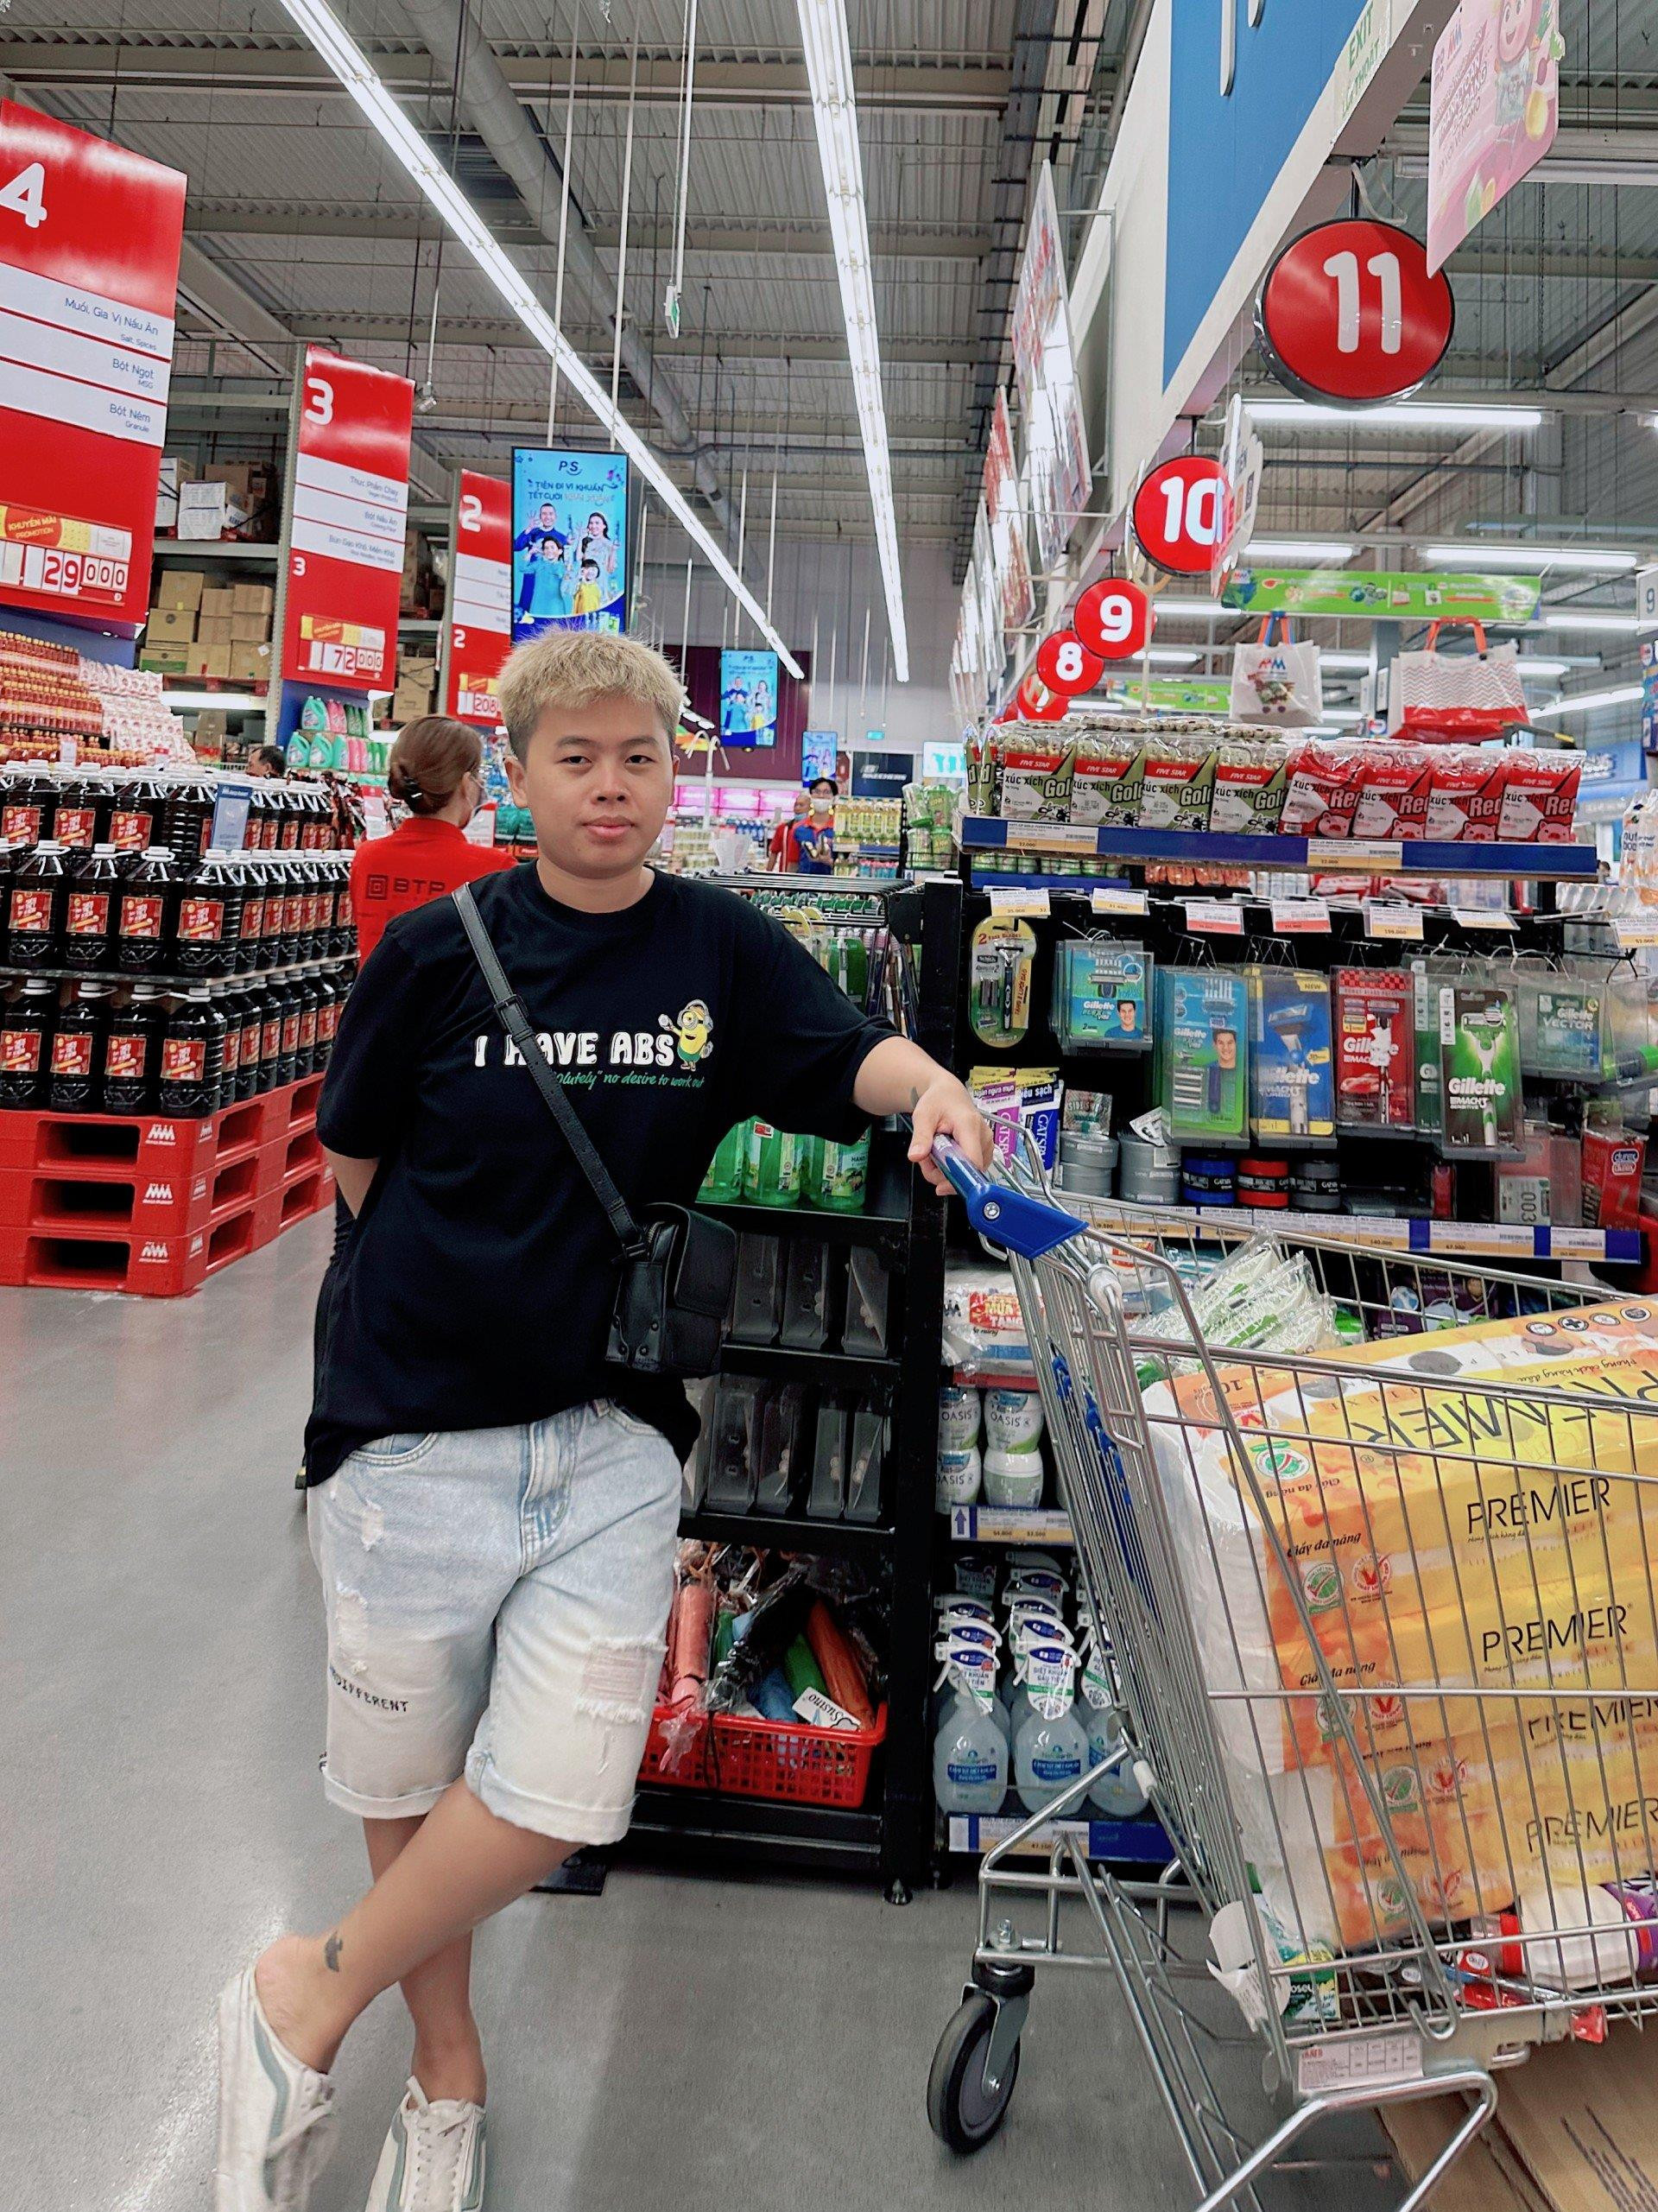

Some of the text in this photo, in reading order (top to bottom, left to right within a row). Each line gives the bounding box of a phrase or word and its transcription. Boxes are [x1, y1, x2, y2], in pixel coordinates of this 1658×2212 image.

[0, 162, 47, 228] 4
[93, 307, 108, 320] Gia
[1323, 250, 1402, 354] 11
[305, 377, 333, 426] 3
[461, 494, 483, 532] 2
[1161, 475, 1222, 546] 10
[293, 557, 306, 576] 3
[1646, 587, 1655, 614] 9
[1099, 594, 1133, 643] 9
[454, 629, 465, 648] 2
[1055, 642, 1084, 681] 8
[978, 933, 988, 945] 2
[1083, 1000, 1116, 1011] Gillette
[1557, 1007, 1593, 1021] Gillette
[1174, 1027, 1206, 1038] Gillette
[475, 1035, 488, 1067] I
[610, 1031, 674, 1067] ABS
[1344, 1036, 1399, 1055] Gille
[604, 1074, 620, 1084] no
[621, 1071, 656, 1085] desire
[658, 1075, 668, 1086] to
[1448, 1077, 1506, 1096] Gillette
[1521, 1191, 1536, 1222] 003
[941, 1410, 972, 1422] OASIS
[990, 1410, 1022, 1428] OASIS
[1467, 1477, 1611, 1534] PREMIER
[1483, 1605, 1628, 1662] PREMIER
